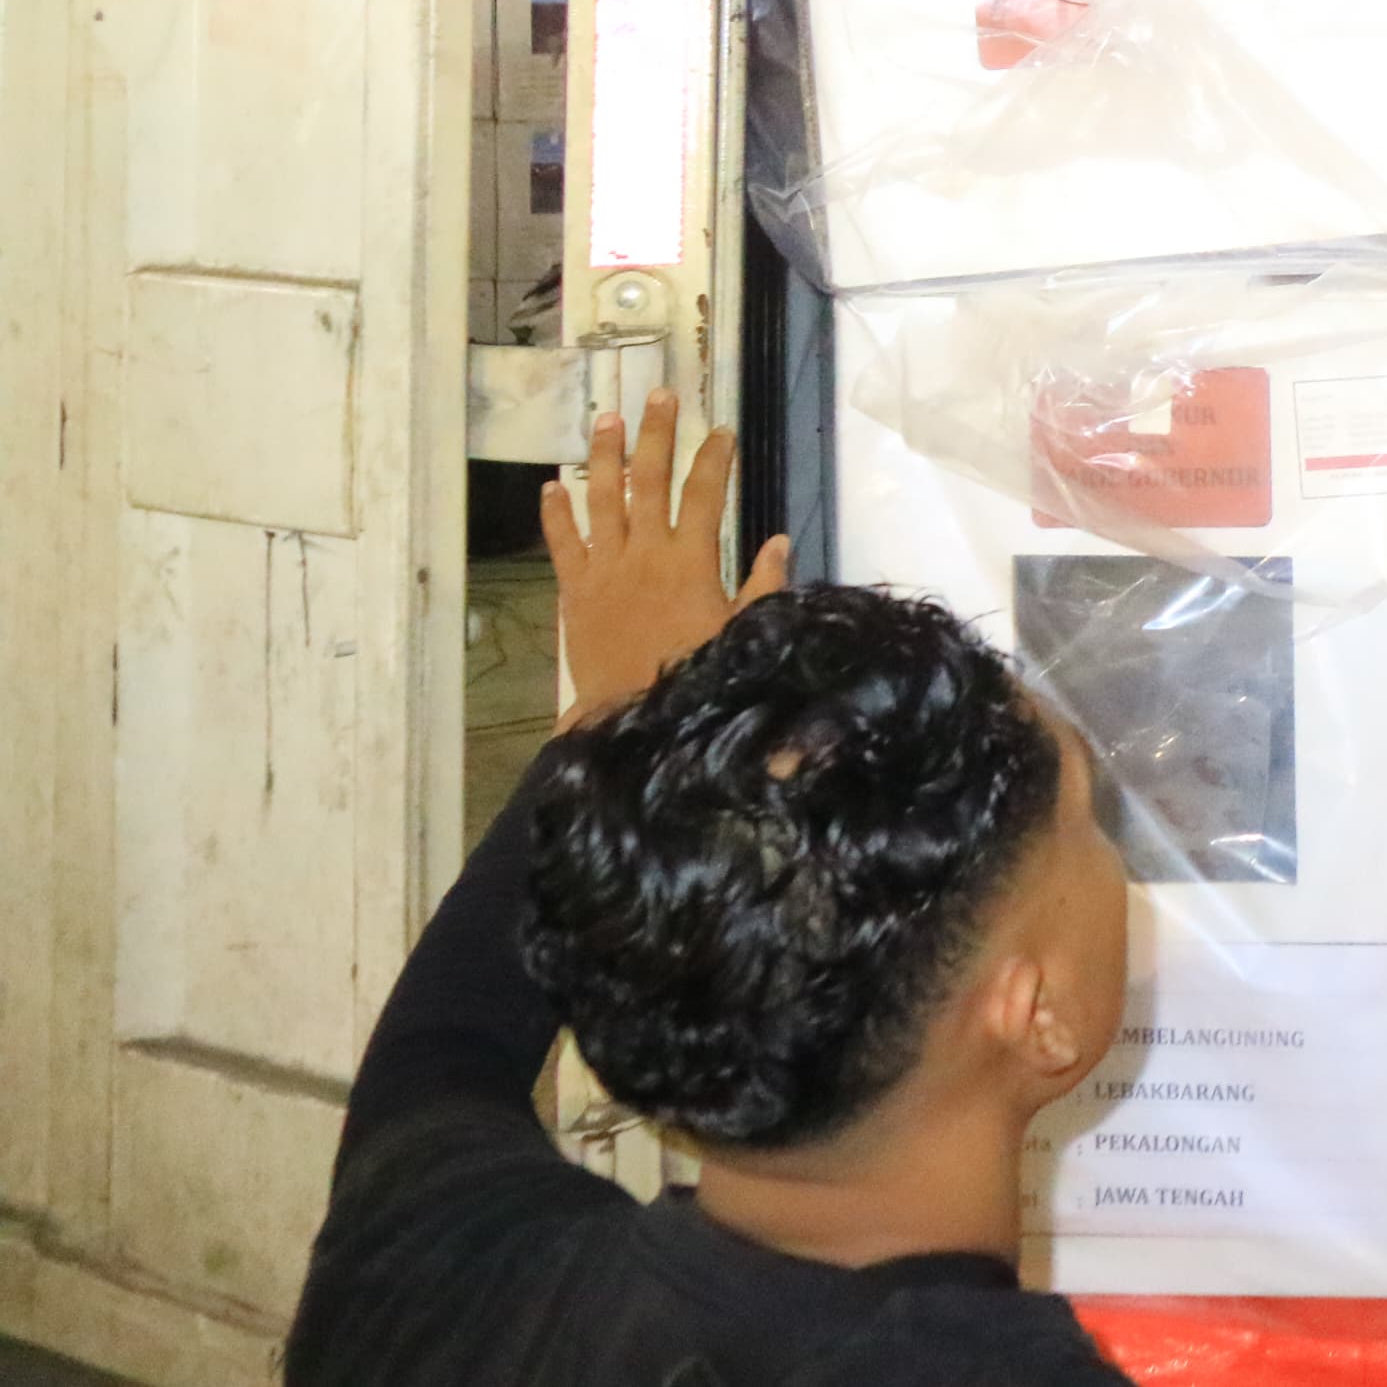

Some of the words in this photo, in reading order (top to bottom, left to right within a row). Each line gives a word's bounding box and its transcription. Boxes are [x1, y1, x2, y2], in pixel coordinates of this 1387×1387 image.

[1095, 1081, 1256, 1103] LEBAKBARANG
[1095, 1133, 1241, 1154] PEKALONGAN
[1095, 1187, 1150, 1207] JAWA
[1155, 1188, 1245, 1207] TENGAH
